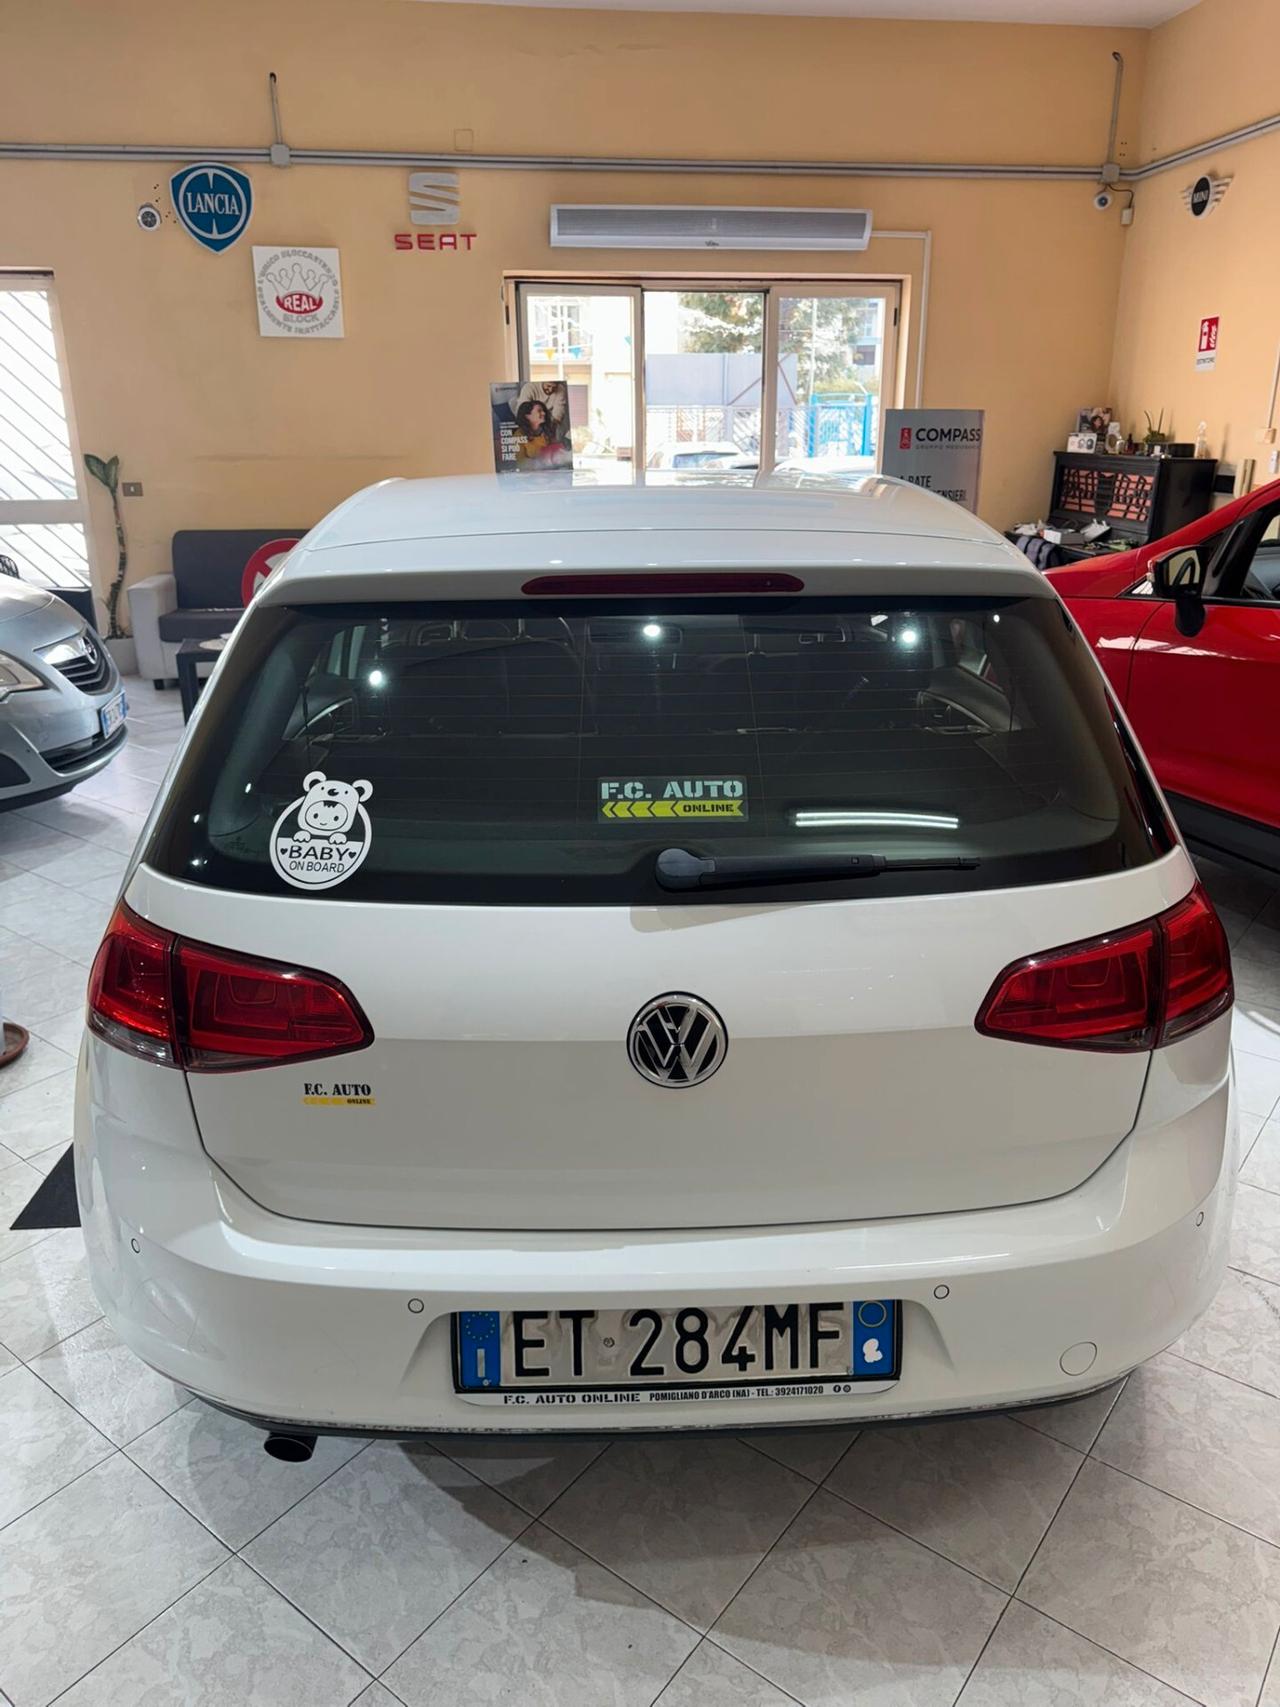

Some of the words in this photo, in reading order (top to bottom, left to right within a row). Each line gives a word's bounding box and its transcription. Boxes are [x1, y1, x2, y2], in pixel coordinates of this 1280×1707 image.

[186, 192, 240, 215] LANCIA
[394, 233, 477, 250] SEAT
[283, 294, 317, 311] REAL
[282, 313, 320, 323] BLOCK
[915, 427, 982, 442] COMPASS
[601, 781, 652, 800] F.C.
[662, 780, 744, 798] AUTO
[682, 803, 735, 813] ONLINE
[288, 845, 350, 861] BABY
[289, 860, 305, 871] ON
[306, 861, 345, 873] BOARD
[303, 1083, 328, 1096] F.C.
[332, 1083, 372, 1096] AUTO
[511, 1310, 596, 1378] ET
[503, 1394, 530, 1405] F.C.
[535, 1393, 576, 1405] AUTO
[581, 1392, 641, 1404] ONLINE
[649, 1390, 700, 1401] POMIGLIANO
[701, 1389, 731, 1400] D'ARCO
[775, 1385, 824, 1397] 3924171020
